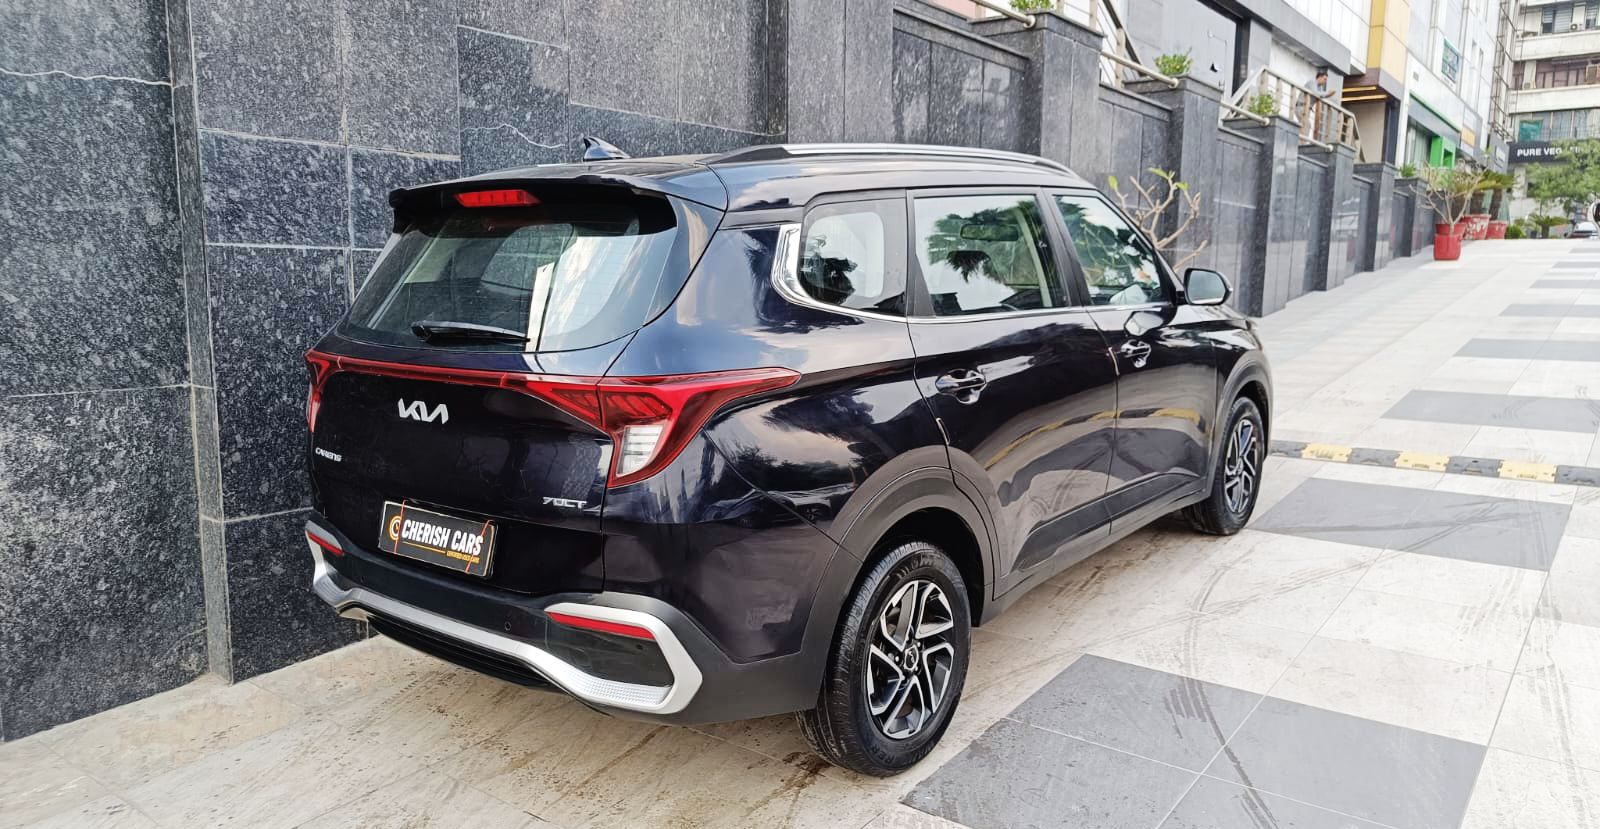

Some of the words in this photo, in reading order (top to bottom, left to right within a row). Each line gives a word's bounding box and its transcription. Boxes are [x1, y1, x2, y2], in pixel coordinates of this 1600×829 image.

[1517, 148, 1542, 157] PURE
[401, 519, 451, 549] CHERISH
[451, 530, 484, 556] CARS
